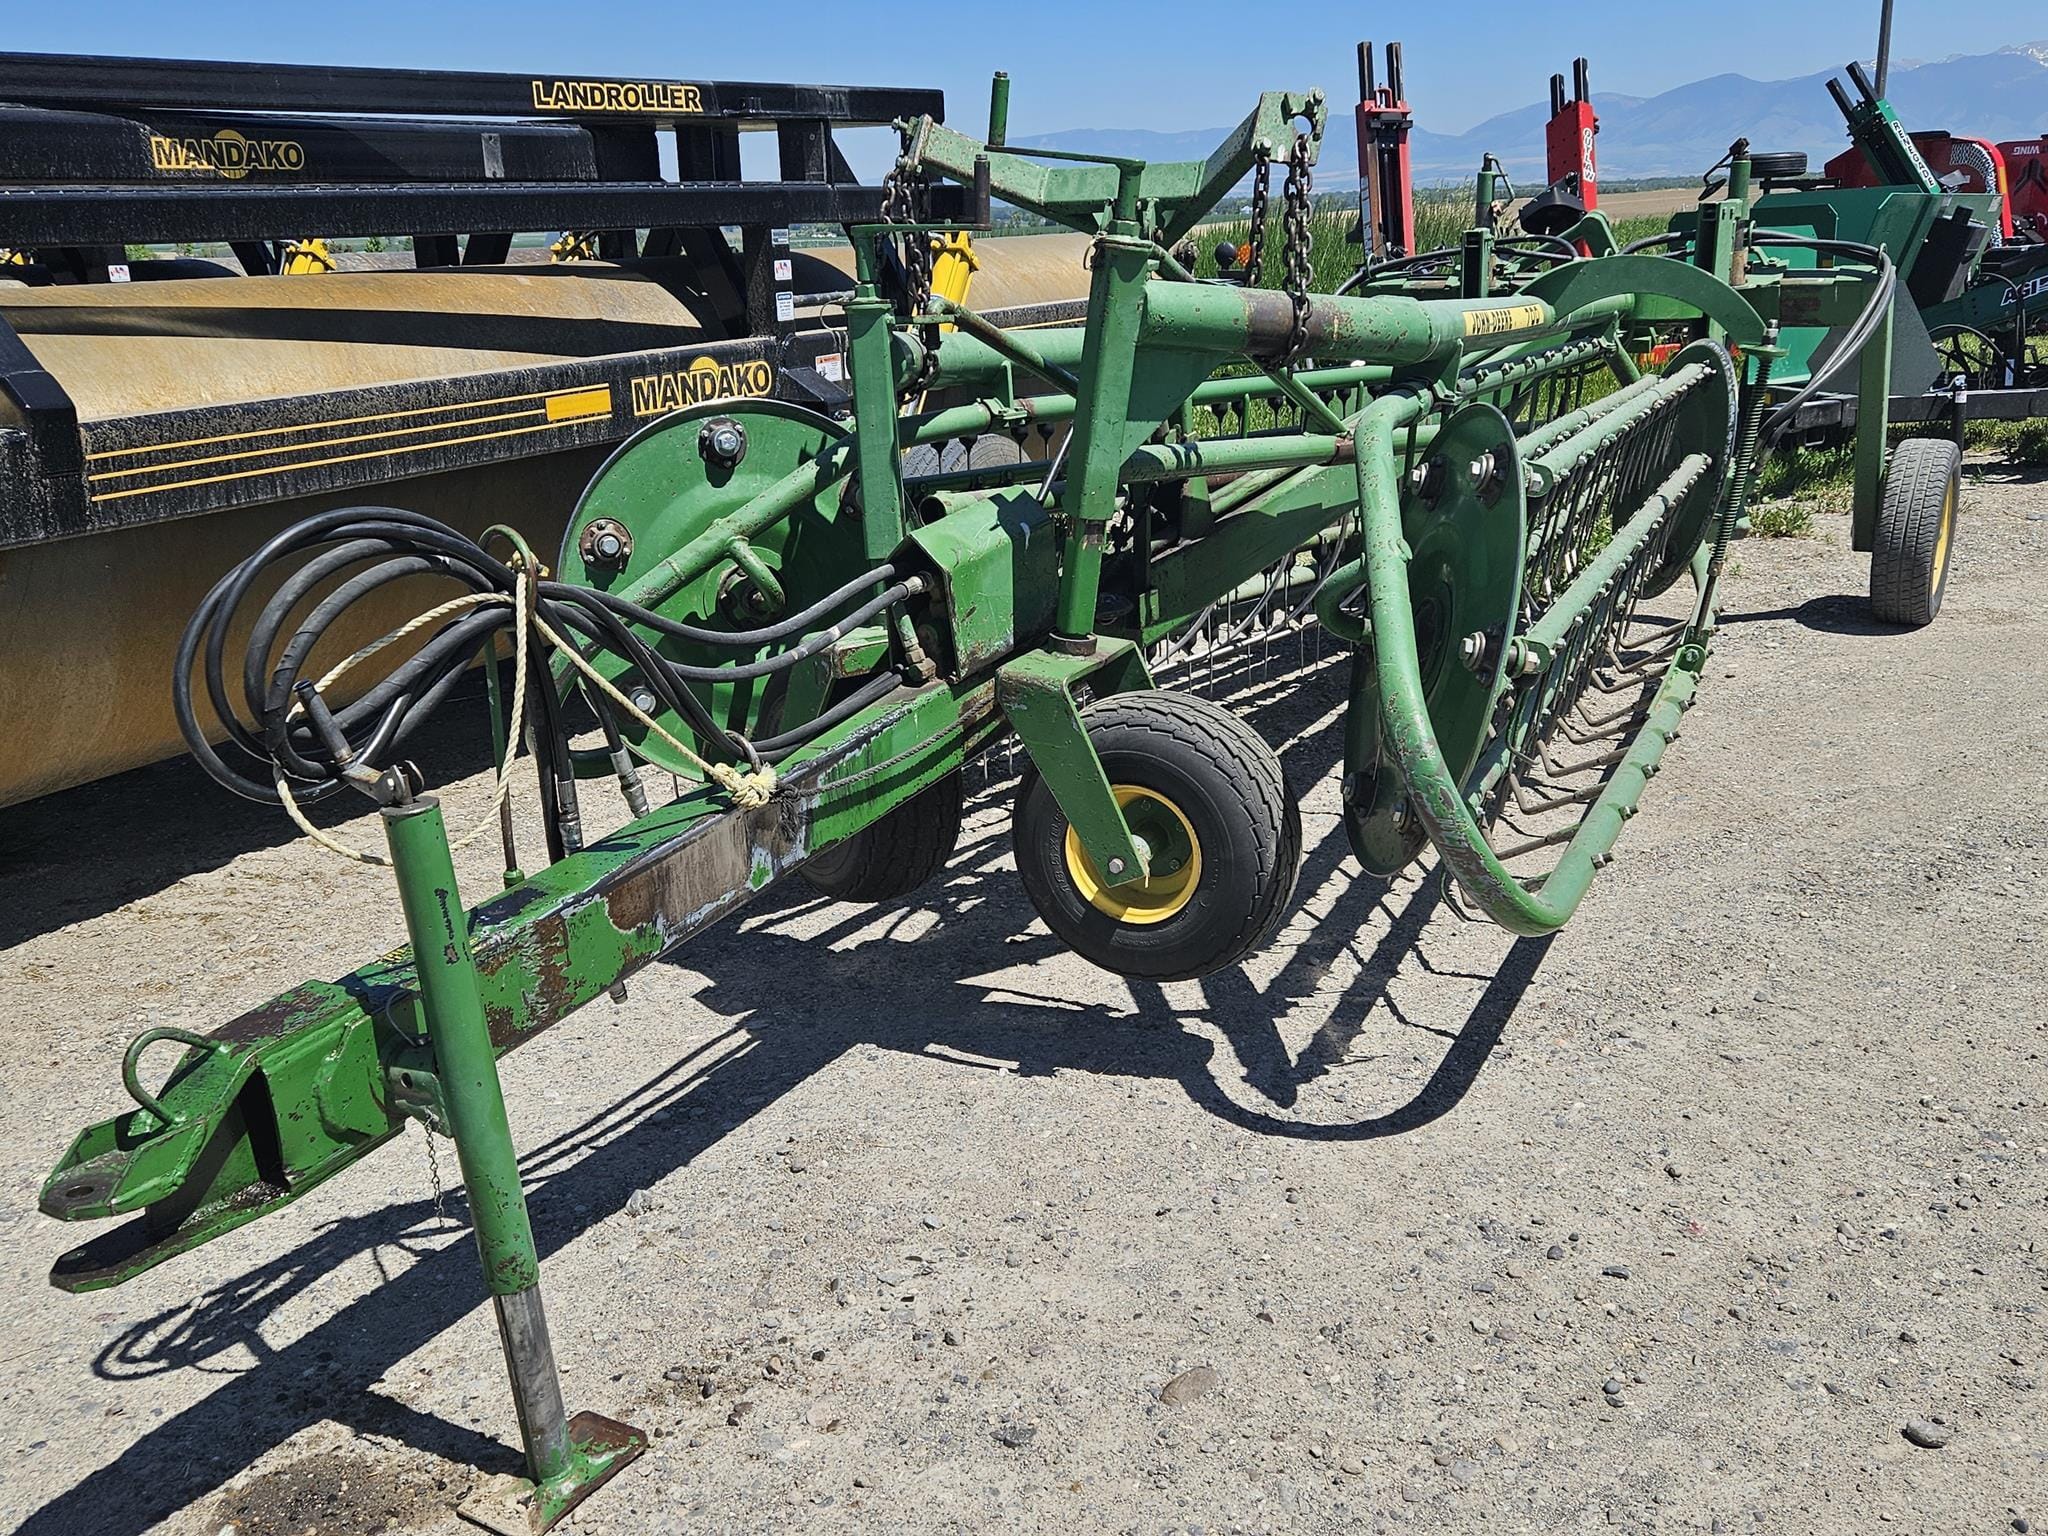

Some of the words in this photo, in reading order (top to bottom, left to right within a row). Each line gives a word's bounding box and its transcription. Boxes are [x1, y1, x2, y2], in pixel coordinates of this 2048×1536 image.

[532, 80, 703, 113] LANDROLLER
[150, 136, 305, 171] MANDAKO
[1583, 128, 1595, 182] OUTLAW
[1892, 121, 1935, 187] RENEGADE
[631, 360, 772, 417] MANDAKO
